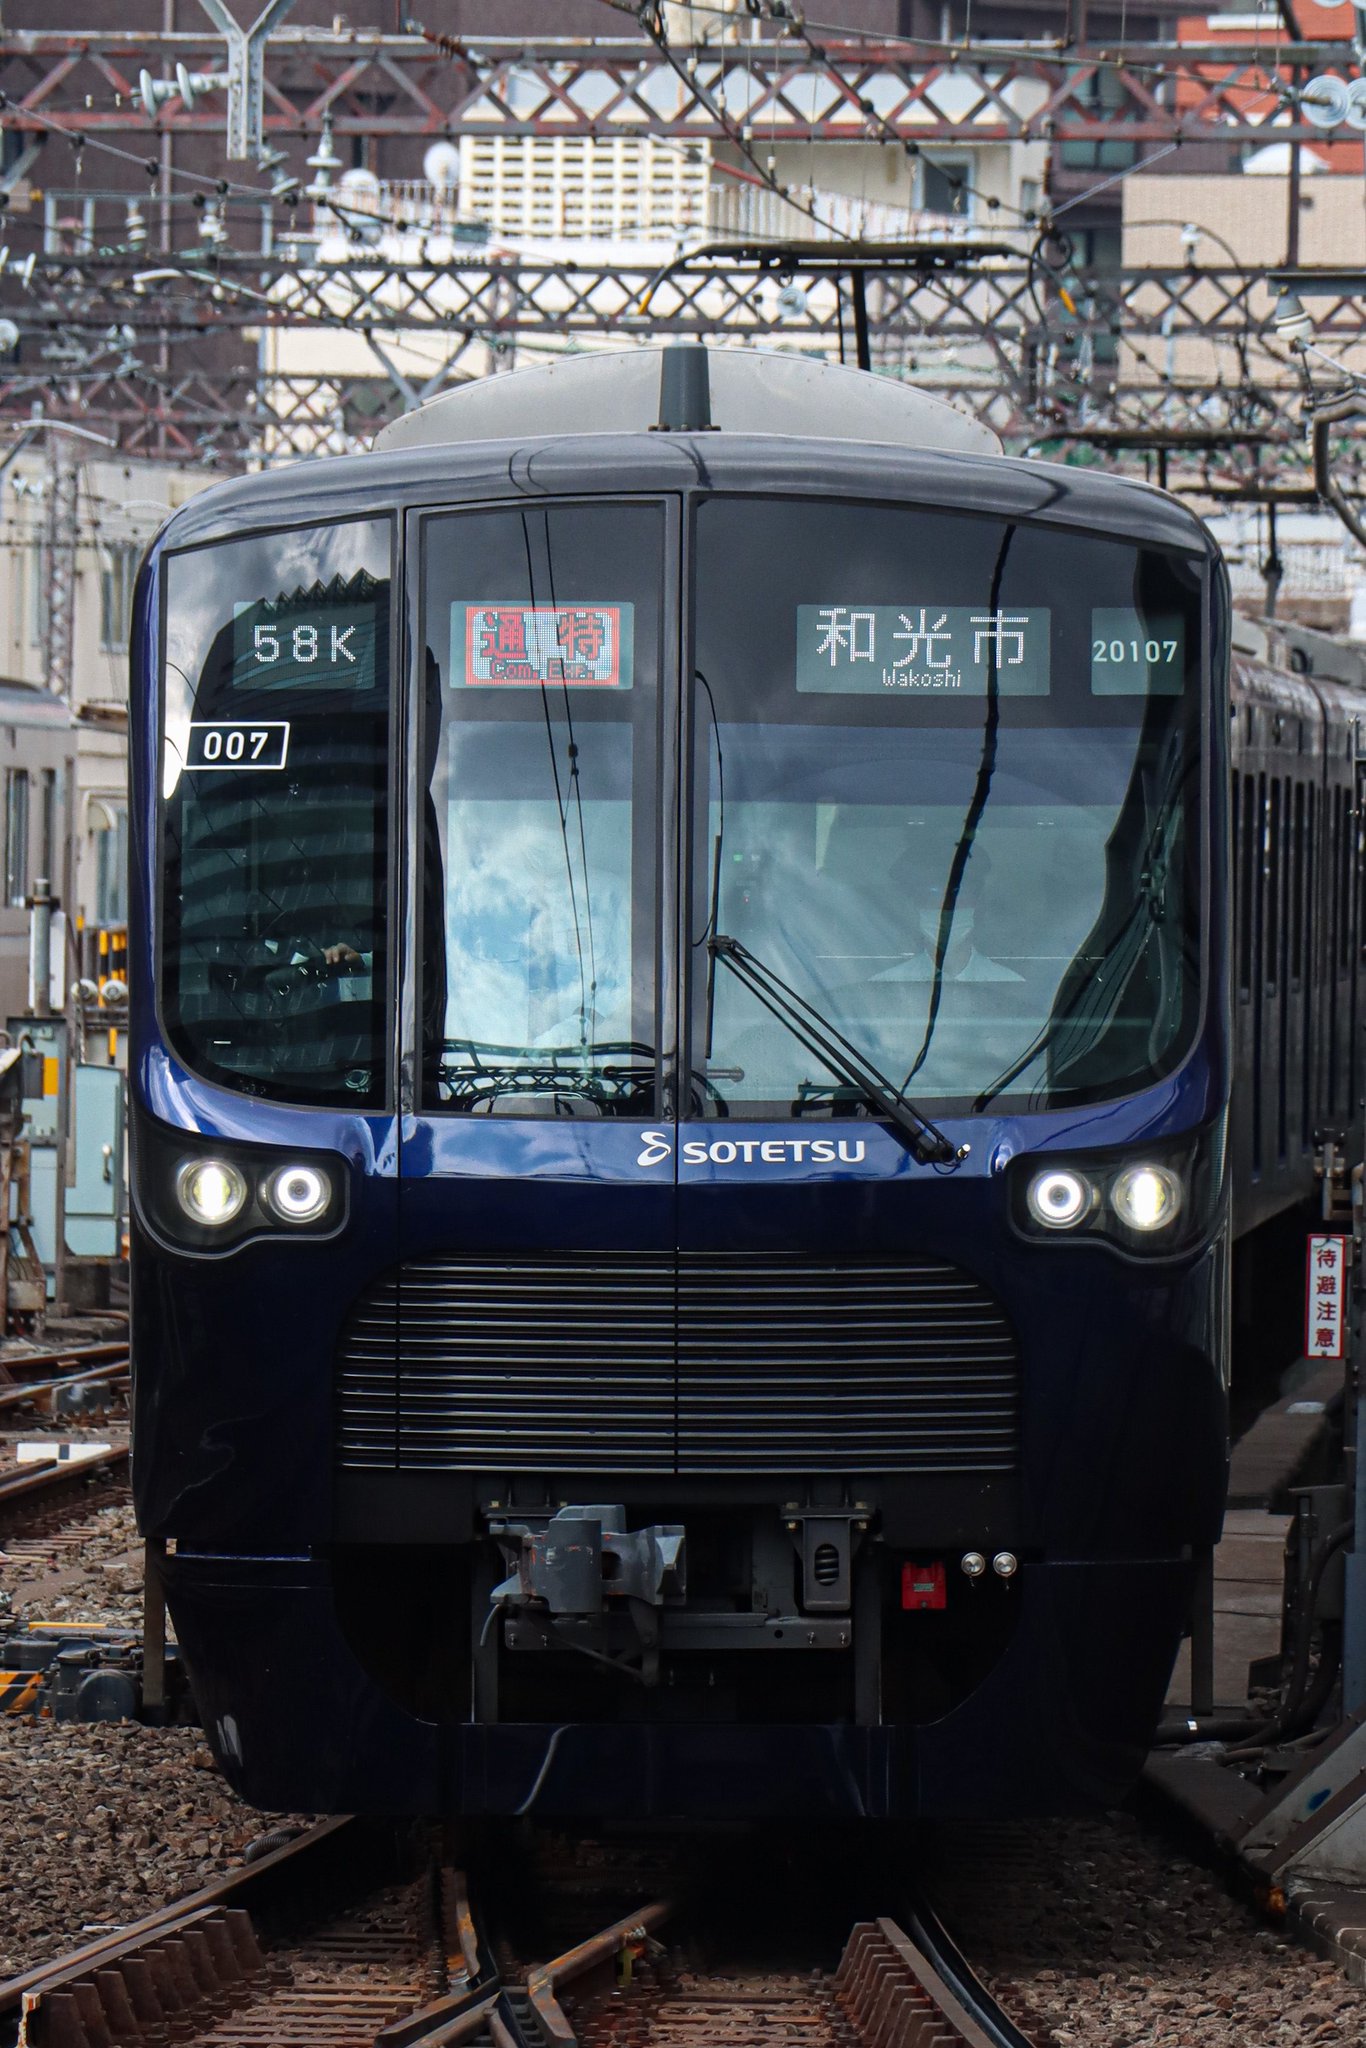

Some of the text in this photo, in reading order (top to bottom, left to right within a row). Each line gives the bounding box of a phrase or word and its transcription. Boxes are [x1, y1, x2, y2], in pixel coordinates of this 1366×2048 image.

[254, 625, 356, 662] 58K
[816, 608, 1029, 668] 和光市
[1092, 640, 1178, 663] 20107
[491, 659, 538, 679] Com.
[882, 668, 961, 687] Wakoshi
[203, 731, 269, 760] 007
[683, 1140, 865, 1164] SOTETSU
[1314, 1248, 1337, 1348] 待避注意
